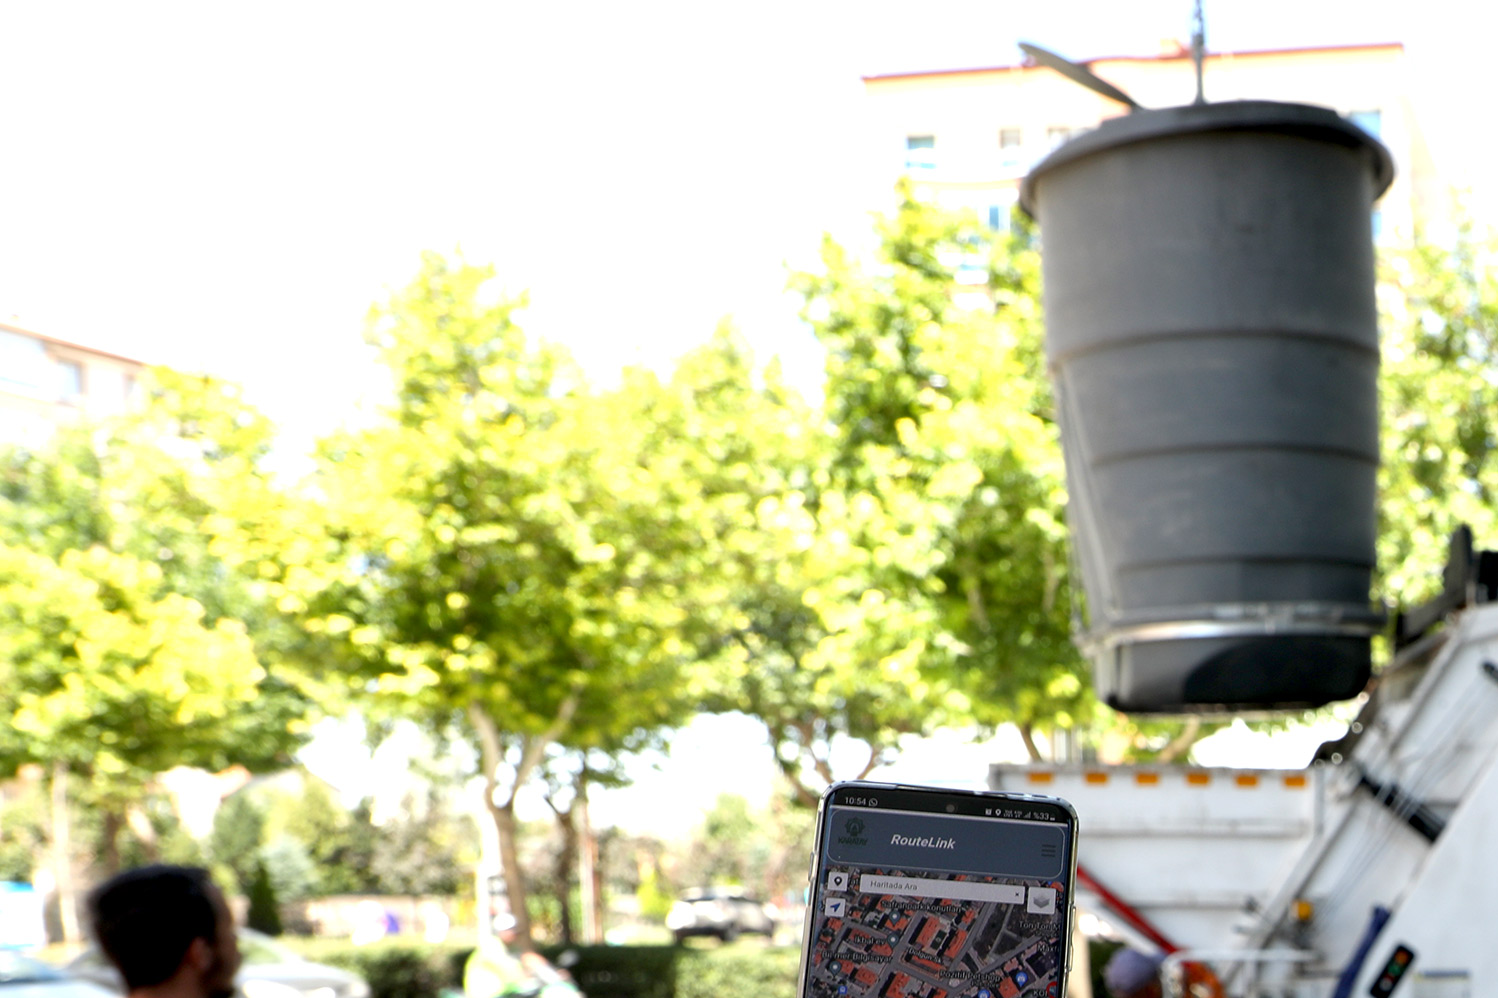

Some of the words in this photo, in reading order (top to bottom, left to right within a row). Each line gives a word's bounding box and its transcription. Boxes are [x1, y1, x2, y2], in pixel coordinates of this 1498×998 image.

[844, 796, 867, 806] 10:54
[1033, 811, 1050, 821] %33
[890, 834, 956, 849] RouteLink
[870, 880, 903, 890] Haritada
[904, 883, 918, 891] Ara
